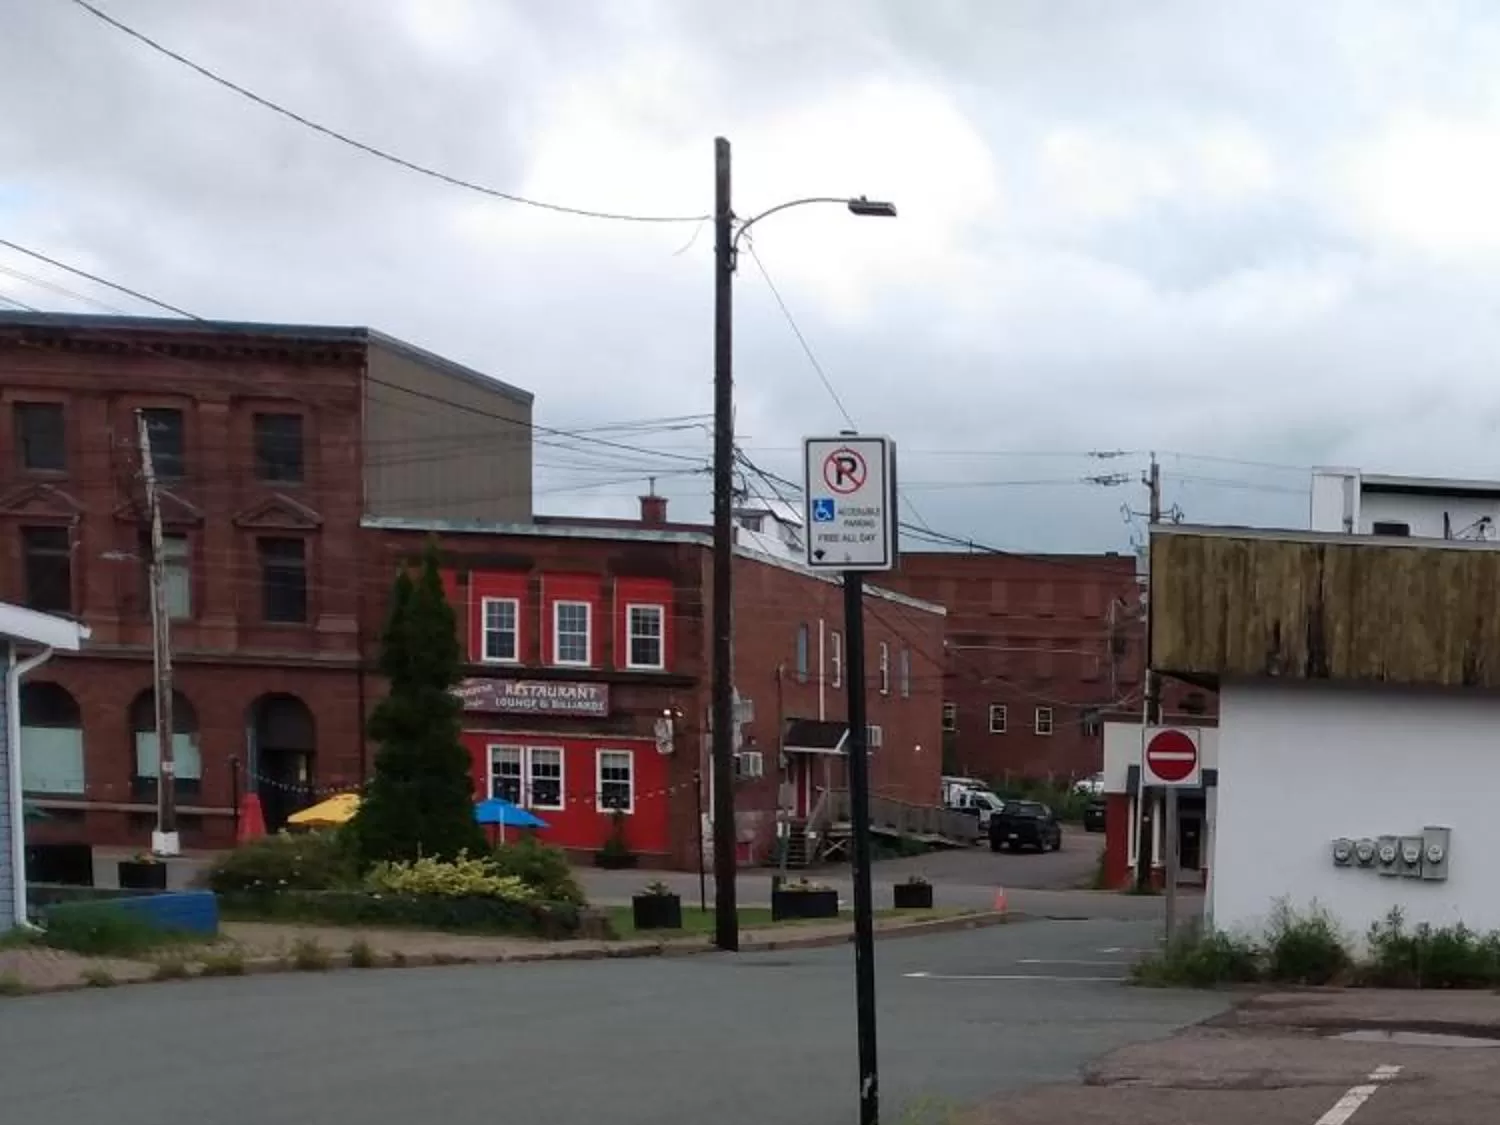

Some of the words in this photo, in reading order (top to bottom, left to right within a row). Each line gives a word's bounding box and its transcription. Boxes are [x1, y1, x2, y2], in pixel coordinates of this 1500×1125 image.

[817, 534, 839, 542] FREE
[842, 534, 857, 543] ALL
[859, 533, 876, 543] DAY
[505, 683, 597, 699] RESTAURANT
[495, 697, 537, 709] LOUNGE
